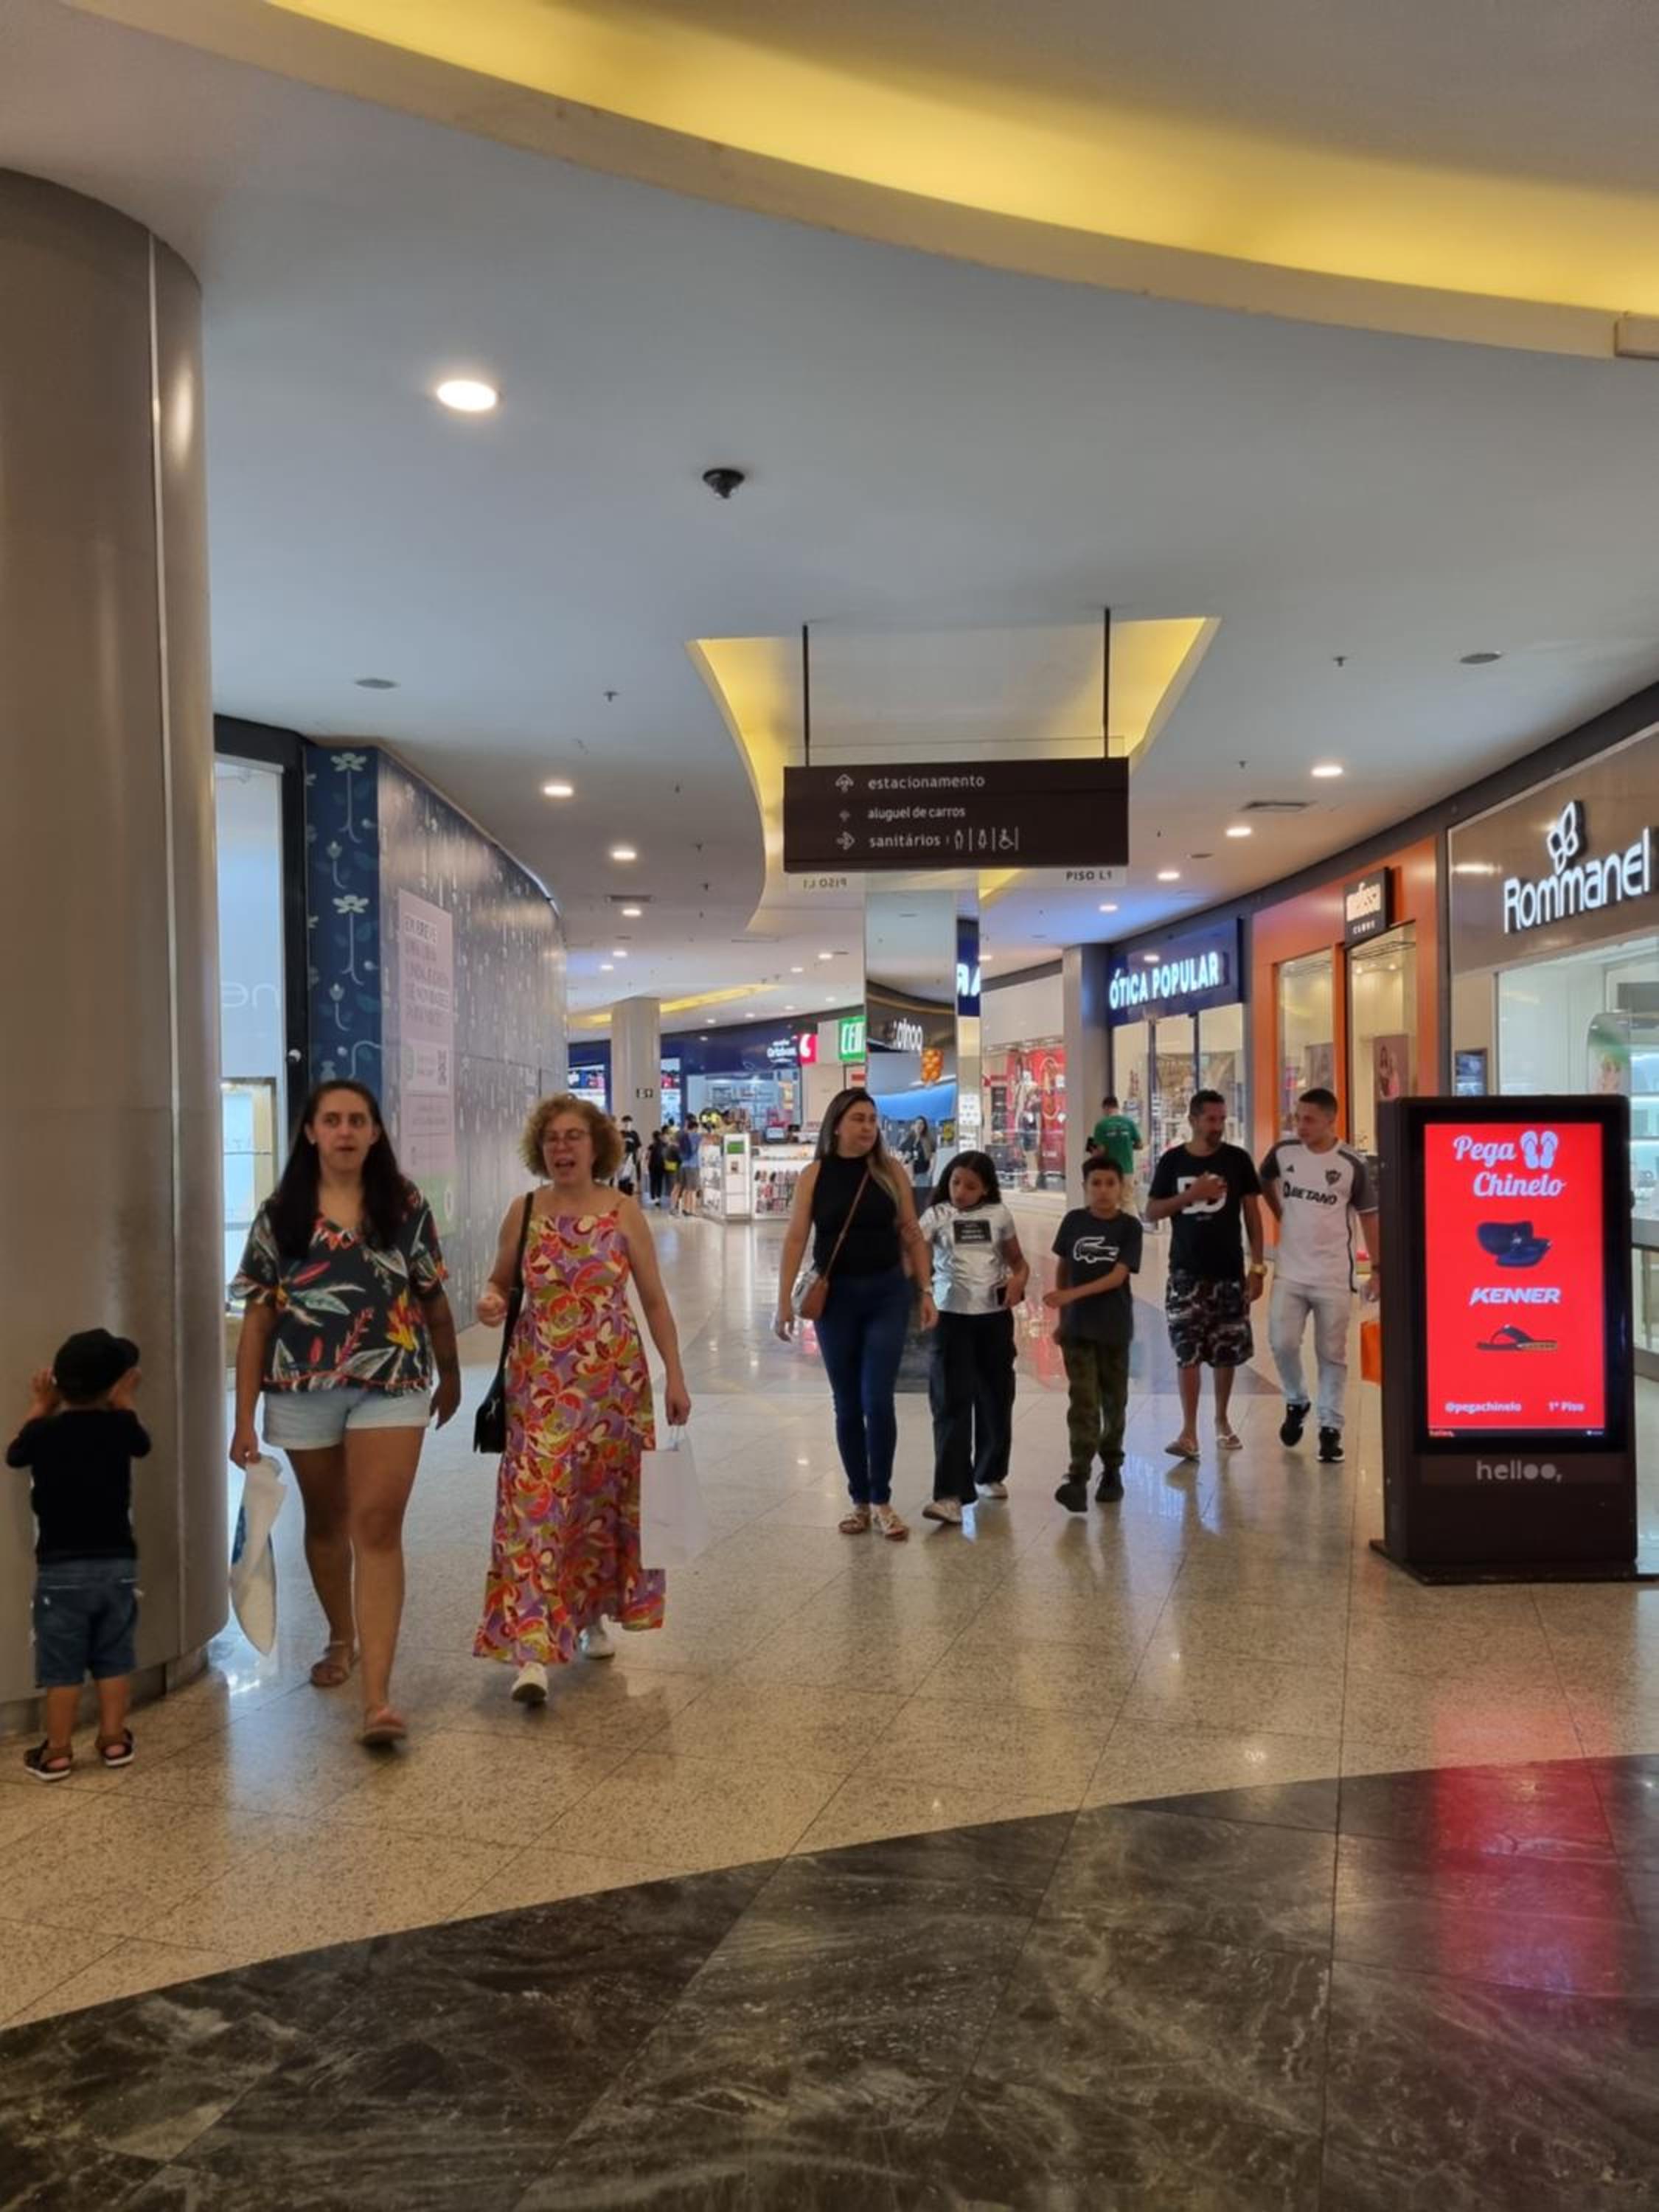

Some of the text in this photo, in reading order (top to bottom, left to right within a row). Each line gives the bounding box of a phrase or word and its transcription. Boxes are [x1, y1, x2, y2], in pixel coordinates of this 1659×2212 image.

[867, 776, 986, 790] estacionamento
[867, 806, 966, 821] aluguel de carros
[869, 833, 941, 848] sanitários
[1066, 871, 1112, 881] PISO L1
[1504, 826, 1650, 933] Rommanel
[1109, 951, 1219, 1010] ÓTICA POPULAR
[1453, 1135, 1517, 1168] Pega
[1472, 1171, 1567, 1197] Chinelo
[1469, 1287, 1561, 1306] KENNER
[1445, 1401, 1522, 1414] @pegachinelo
[1562, 1401, 1585, 1412] Piso
